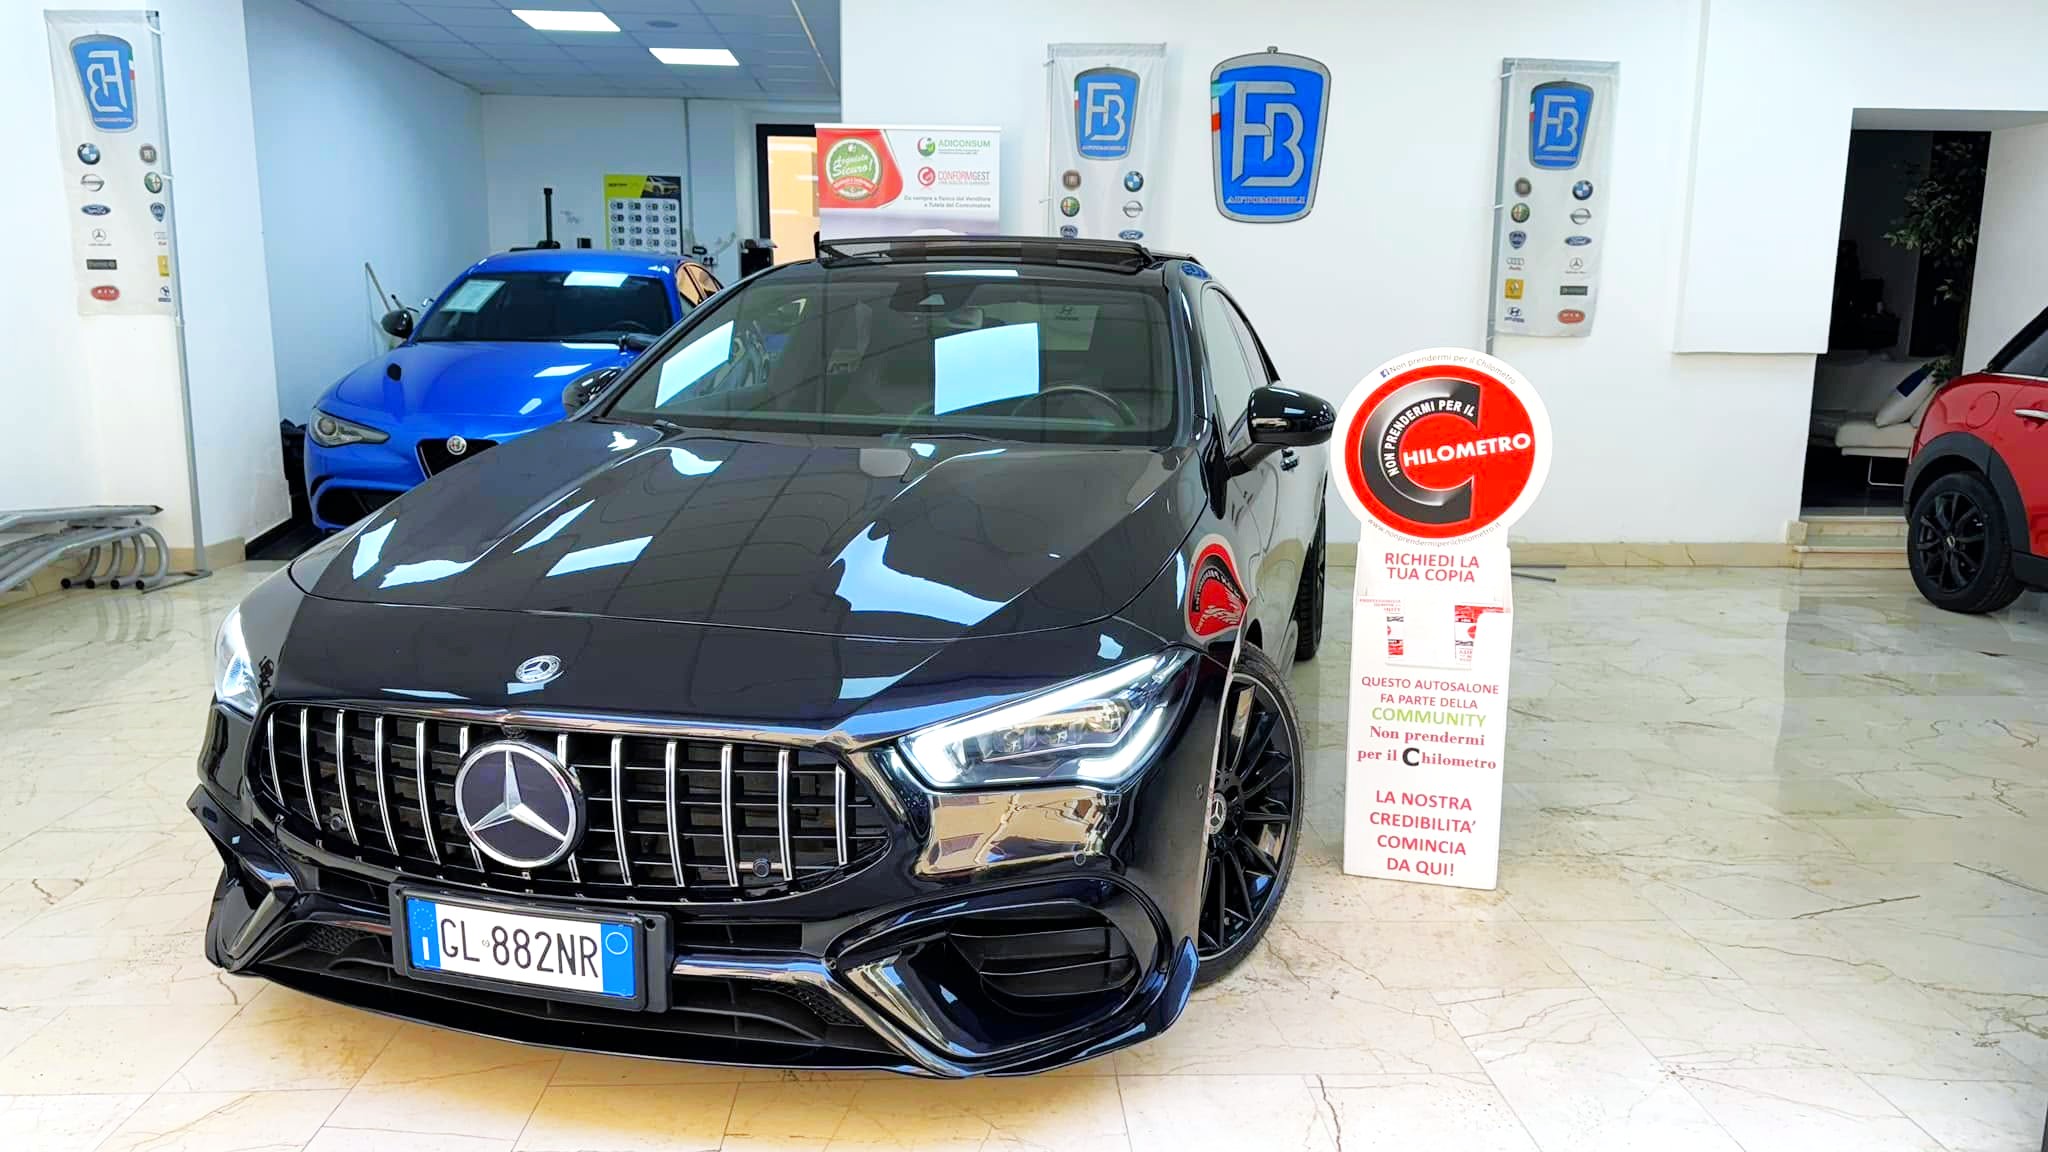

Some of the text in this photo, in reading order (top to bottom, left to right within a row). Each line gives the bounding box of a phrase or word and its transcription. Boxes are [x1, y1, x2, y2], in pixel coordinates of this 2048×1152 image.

[1085, 82, 1126, 141] FB
[1231, 80, 1305, 187] FB
[1538, 94, 1579, 152] FB
[938, 139, 991, 148] ADICONSUM
[938, 170, 991, 181] CONFORMGEST
[1389, 362, 1406, 374] Non
[1408, 353, 1452, 367] prendermi
[1453, 355, 1468, 363] per
[1476, 358, 1517, 385] Chilometro
[1383, 400, 1476, 478] NON PRENDERMI PER IL
[1385, 552, 1480, 569] RICHIEDI LA
[1386, 567, 1476, 583] TUA COPIA
[1361, 676, 1500, 695] QUESTO AUTOSALONE
[1380, 693, 1478, 710] FA PARTE DELLA
[1371, 707, 1487, 728] COMMUNITY
[1369, 725, 1486, 747] Non prendermi
[1357, 749, 1382, 762] per
[1387, 748, 1397, 761] il
[1376, 790, 1472, 811] LA NOSTRA
[1377, 834, 1467, 856] COMINCIA
[1387, 857, 1454, 877] DA QUI!
